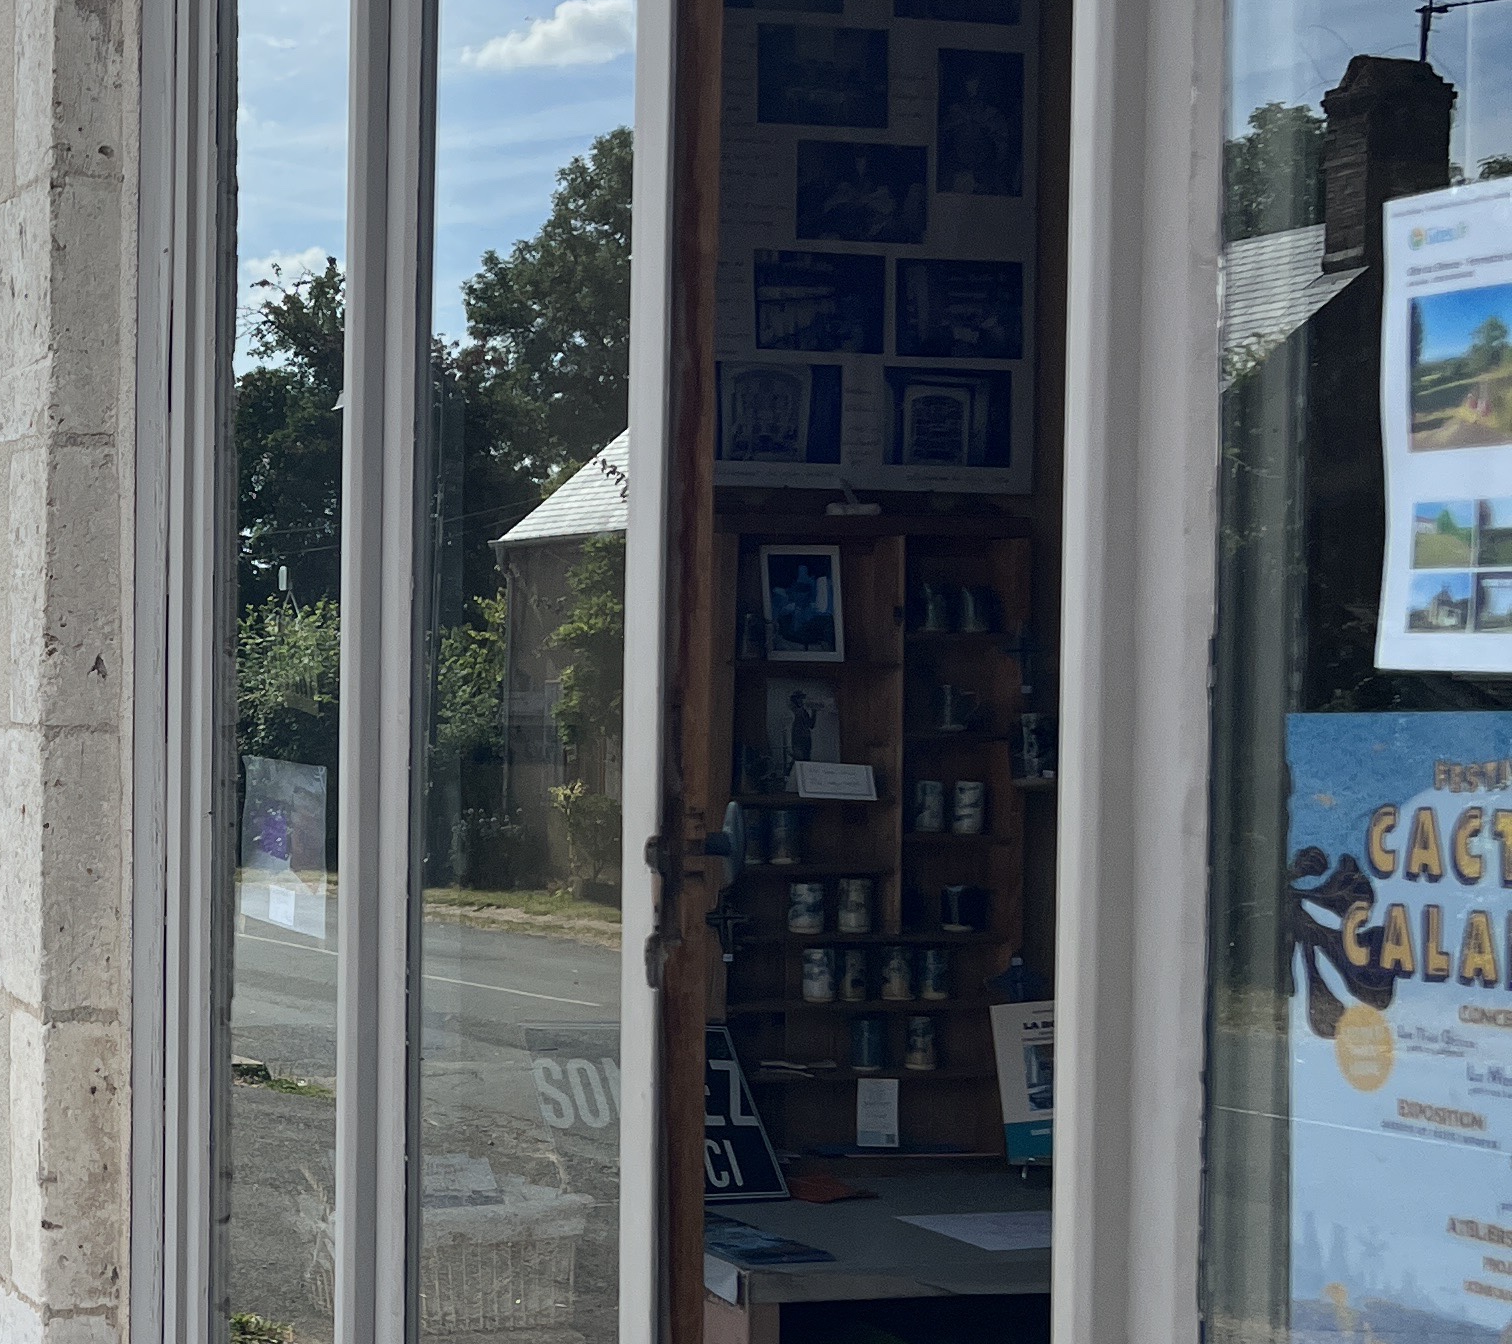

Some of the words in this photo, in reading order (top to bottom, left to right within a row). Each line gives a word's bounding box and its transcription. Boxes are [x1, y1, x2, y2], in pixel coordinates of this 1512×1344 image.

[1433, 759, 1512, 793] FESTI
[1343, 901, 1512, 989] CALA
[703, 1139, 744, 1189] CI
